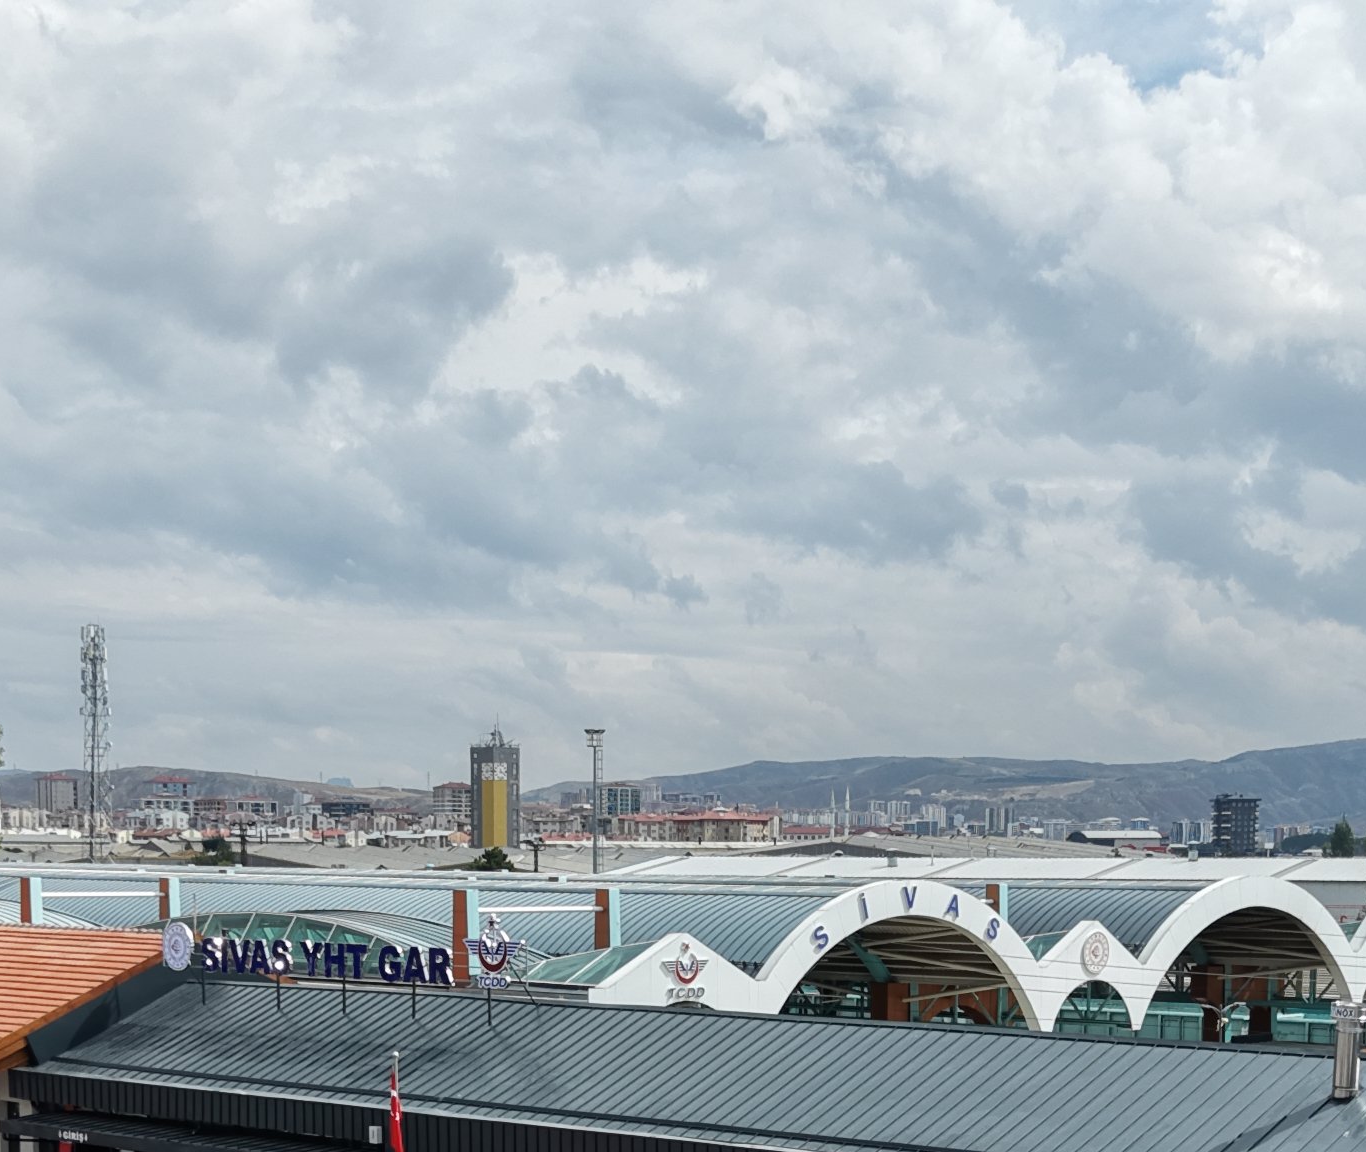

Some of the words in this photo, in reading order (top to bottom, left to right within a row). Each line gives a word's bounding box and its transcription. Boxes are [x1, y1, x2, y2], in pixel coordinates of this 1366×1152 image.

[300, 940, 368, 979] YHT
[378, 945, 454, 986] GAR
[478, 976, 508, 988] TCDD
[666, 986, 705, 999] TCDD
